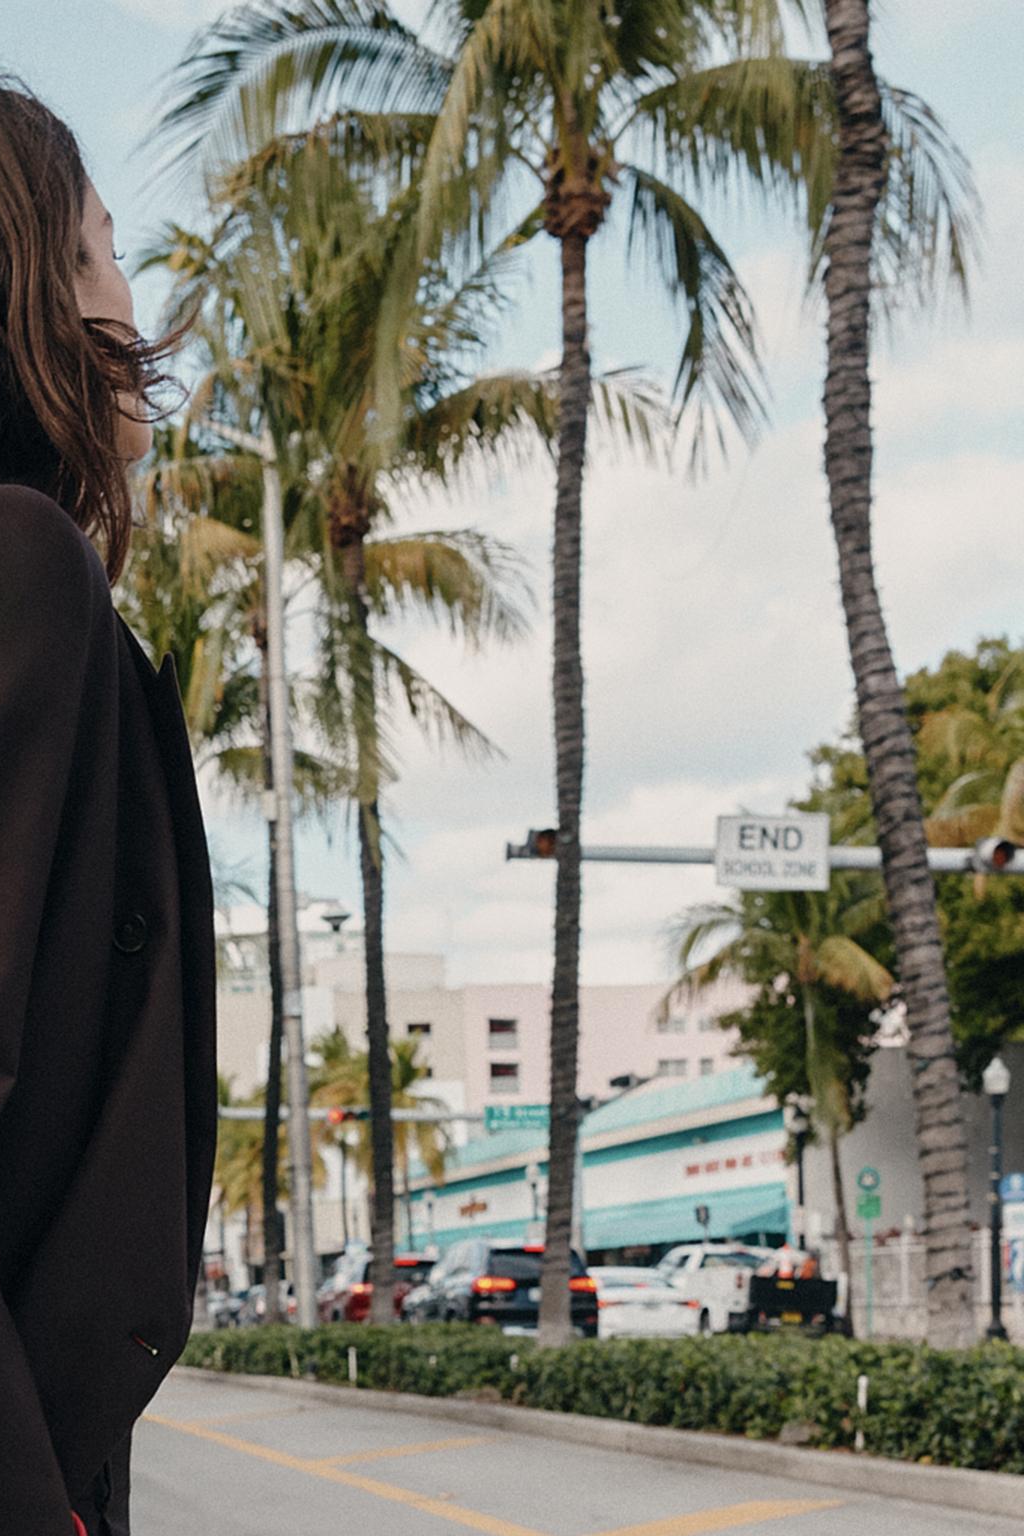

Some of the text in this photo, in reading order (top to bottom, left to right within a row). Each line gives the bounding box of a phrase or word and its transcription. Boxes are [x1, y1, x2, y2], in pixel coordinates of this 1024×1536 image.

[739, 825, 802, 850] END
[724, 858, 816, 877] SCHOOL ZONE
